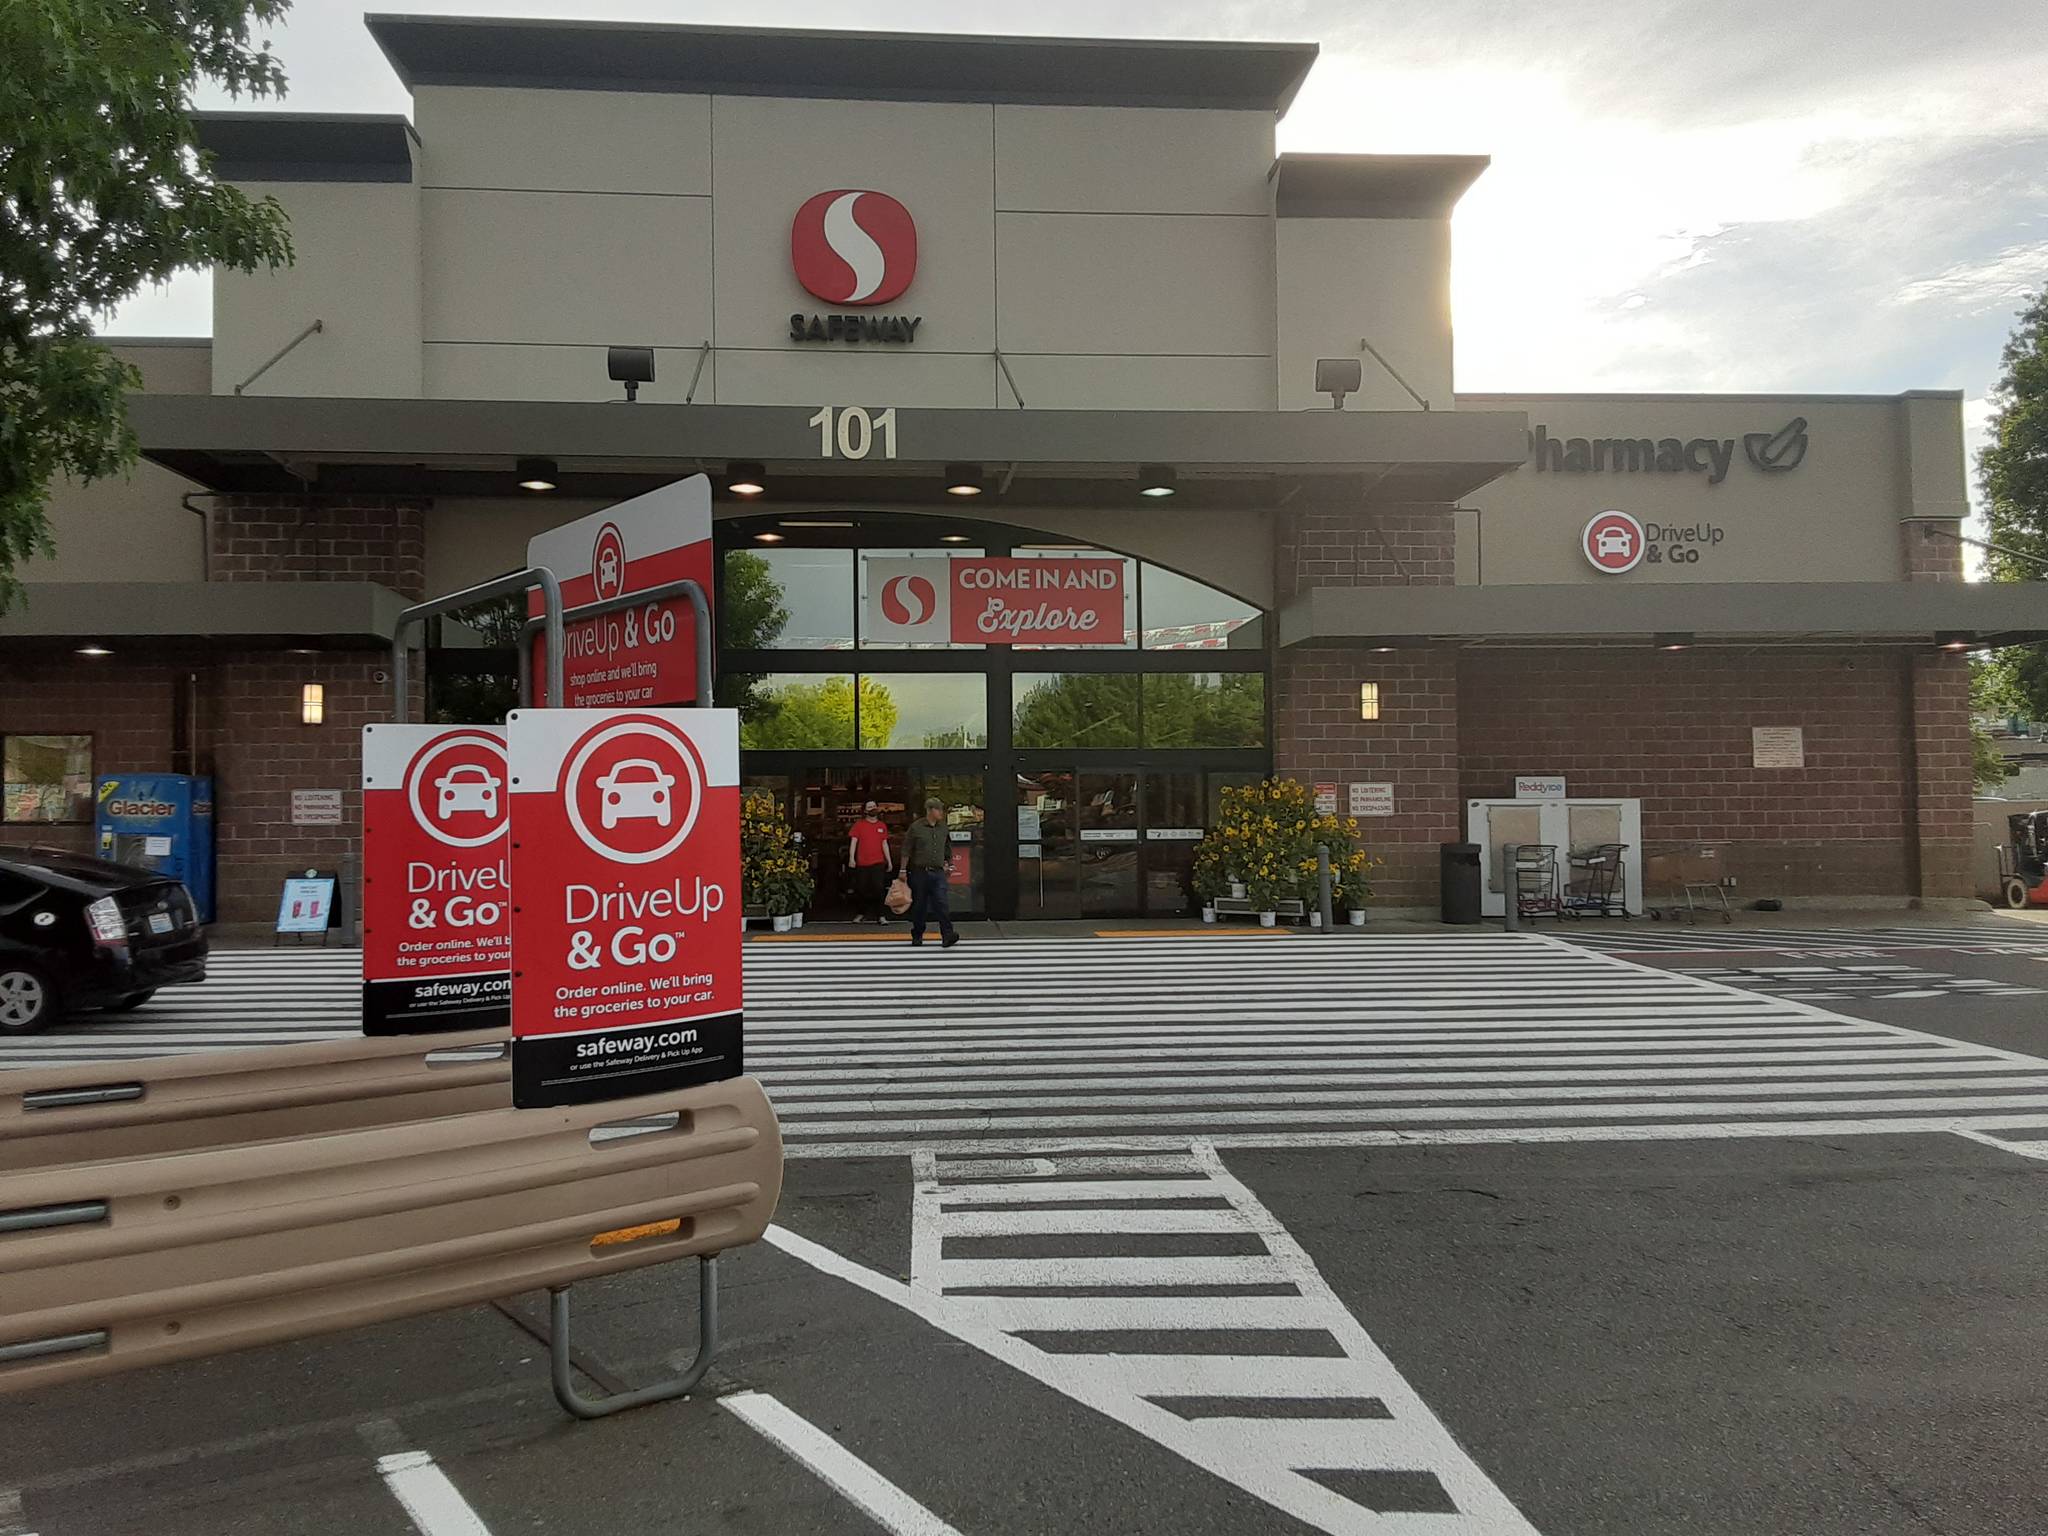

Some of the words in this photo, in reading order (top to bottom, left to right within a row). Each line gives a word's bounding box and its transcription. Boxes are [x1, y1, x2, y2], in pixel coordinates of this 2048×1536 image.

[790, 313, 922, 343] SAFEWAY
[809, 406, 897, 460] 101
[1646, 523, 1724, 547] DriveUp
[1646, 545, 1662, 564] &
[1668, 545, 1699, 564] Go
[959, 567, 1031, 589] COME
[1035, 568, 1060, 589] IN
[1063, 568, 1117, 590] AND
[624, 607, 639, 649] &
[644, 602, 675, 644] Go
[977, 597, 1100, 637] Explore
[570, 673, 586, 688] shop
[587, 668, 606, 683] online
[607, 667, 620, 680] and
[638, 660, 657, 678] bring
[574, 693, 585, 707] the
[585, 689, 615, 708] groceries
[616, 688, 624, 702] to
[624, 687, 640, 704] your
[641, 686, 654, 699] car
[108, 800, 176, 817] Glacier
[408, 898, 437, 930] &
[565, 876, 724, 924] DriveUp
[399, 942, 433, 952] Order
[435, 939, 474, 950] online.
[476, 936, 502, 947] We'll
[567, 930, 601, 970] &
[397, 957, 416, 966] the
[418, 952, 472, 968] groceries
[474, 952, 486, 961] to
[556, 986, 598, 999] Order
[600, 981, 647, 996] online.
[649, 977, 680, 990] We'll
[682, 973, 713, 986] bring
[554, 1006, 578, 1018] the
[581, 999, 644, 1018] groceries
[647, 998, 661, 1008] to
[663, 993, 691, 1009] your
[693, 990, 715, 1002] car.
[576, 1029, 697, 1058] safeway.com
[579, 1062, 592, 1070] use
[593, 1060, 605, 1068] the
[605, 1057, 634, 1067] Safeway
[634, 1053, 660, 1062] Delivery
[681, 1048, 691, 1056] Up
[691, 1046, 704, 1055] App
